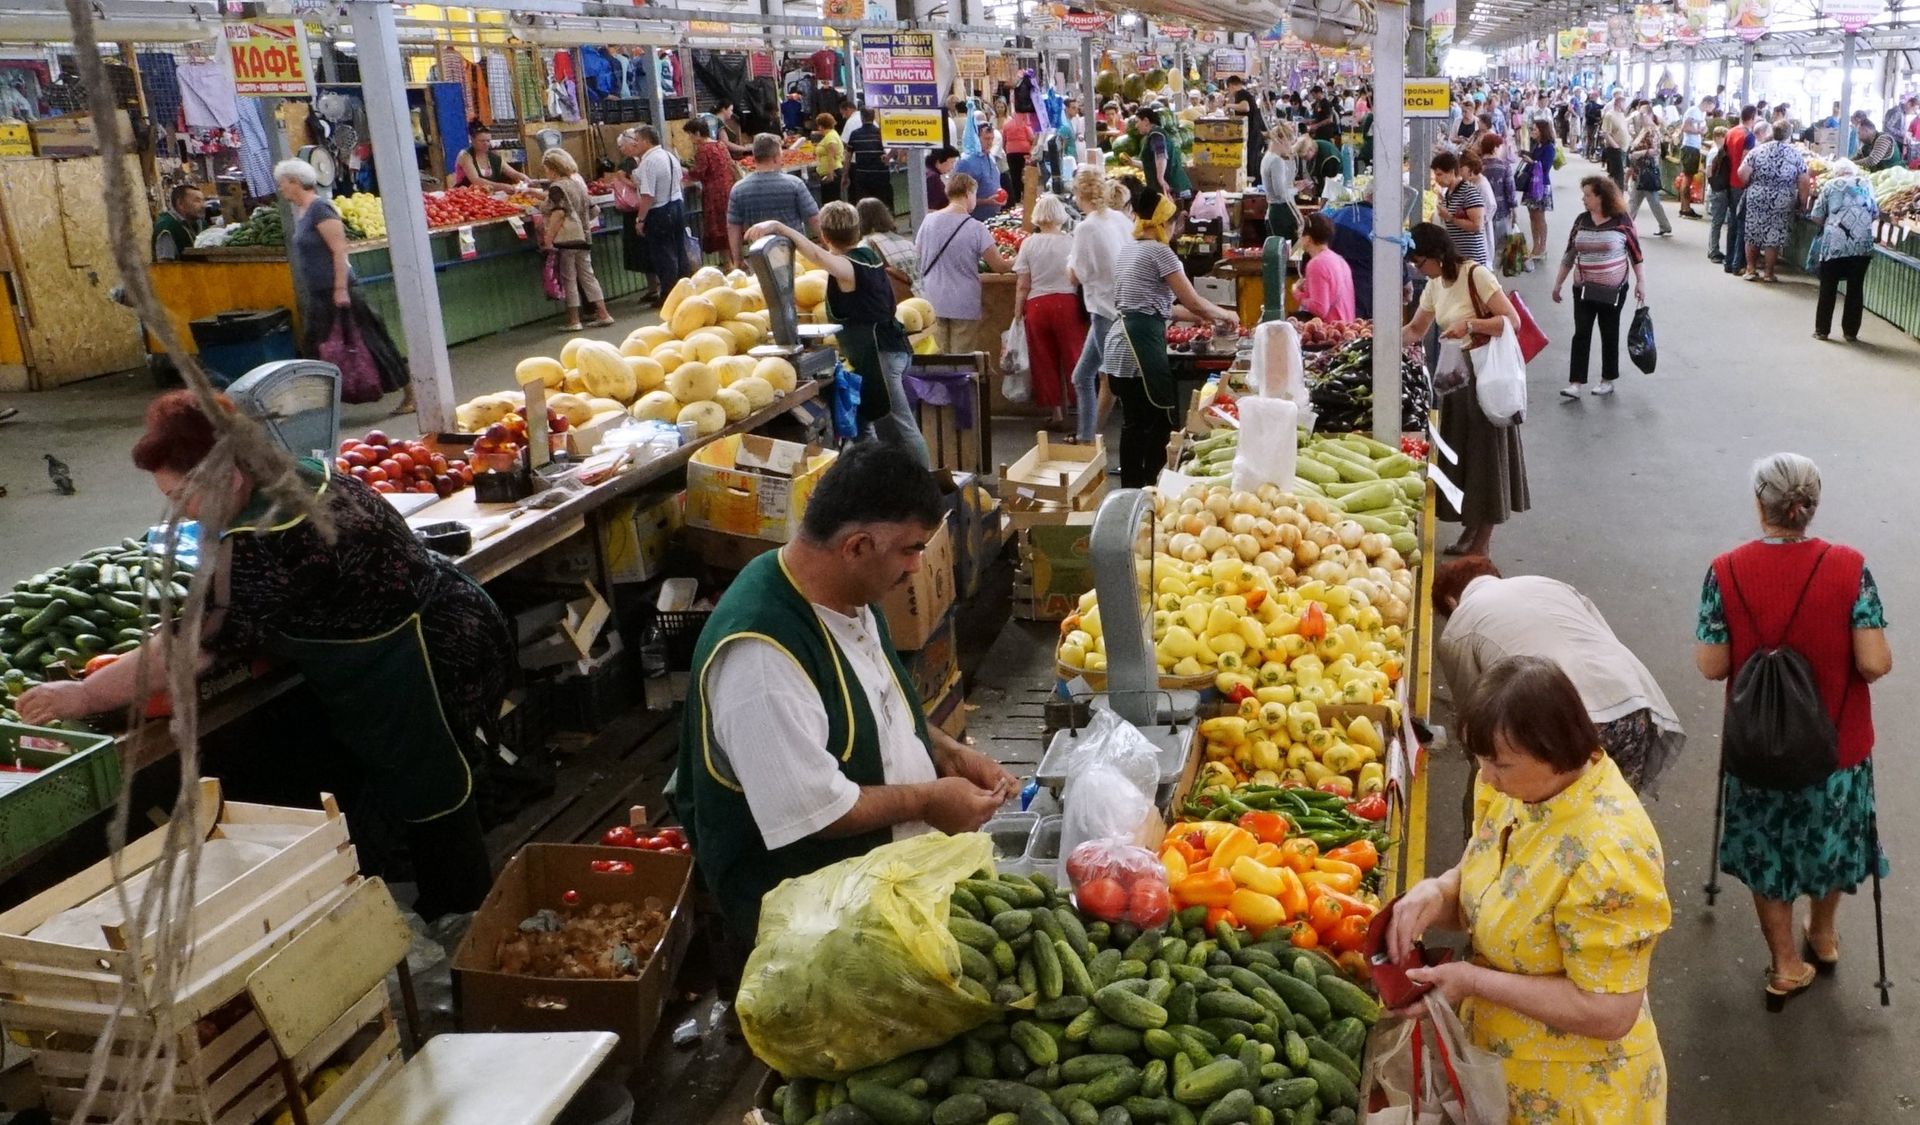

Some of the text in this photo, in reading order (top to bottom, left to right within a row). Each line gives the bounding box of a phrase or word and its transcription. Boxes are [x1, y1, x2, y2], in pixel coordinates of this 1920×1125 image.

[1063, 14, 1106, 24] ЭКОНОМЬ
[892, 35, 931, 45] РЕМОНТ
[892, 46, 932, 56] ОДЕЖДЫ
[231, 45, 302, 78] КАФЕ
[866, 69, 934, 80] ИТАЛЧИСТКА
[1404, 88, 1444, 96] трольные
[872, 94, 933, 106] ТУАЛЕТ
[1404, 97, 1434, 106] есы
[896, 128, 928, 136] весы
